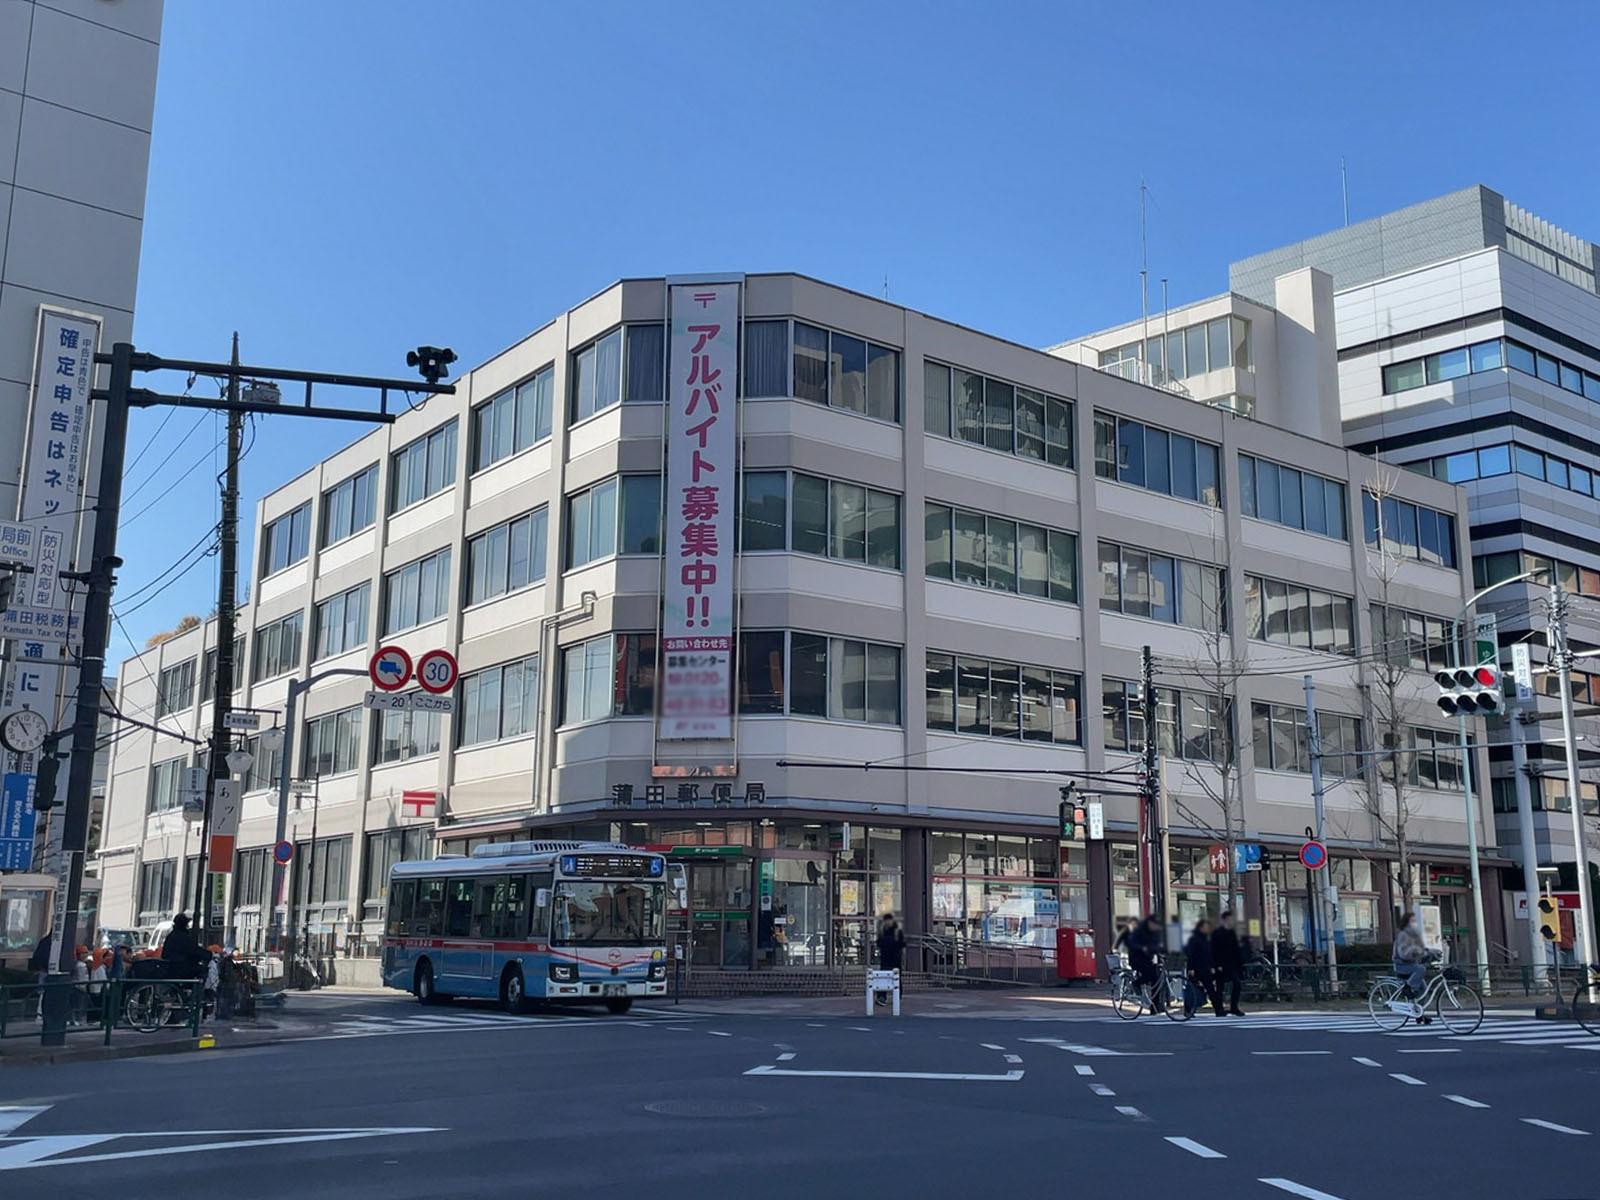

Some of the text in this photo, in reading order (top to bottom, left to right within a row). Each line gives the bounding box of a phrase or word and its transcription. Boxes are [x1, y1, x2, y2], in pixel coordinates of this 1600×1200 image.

[43, 327, 80, 520] 確定申告はネッ
[680, 323, 722, 628] アルバイト募集中!!
[0, 526, 32, 546] 局前
[2, 545, 29, 558] Office
[35, 534, 58, 604] 防災対応型
[3, 625, 34, 637] Kamata
[37, 628, 51, 638] Tax
[667, 639, 729, 650] お問い合わせ先
[425, 661, 450, 682] 30
[369, 694, 376, 705] 7
[391, 696, 405, 708] 20
[415, 698, 452, 711] ここから
[611, 782, 766, 805] 蒲田郵便局
